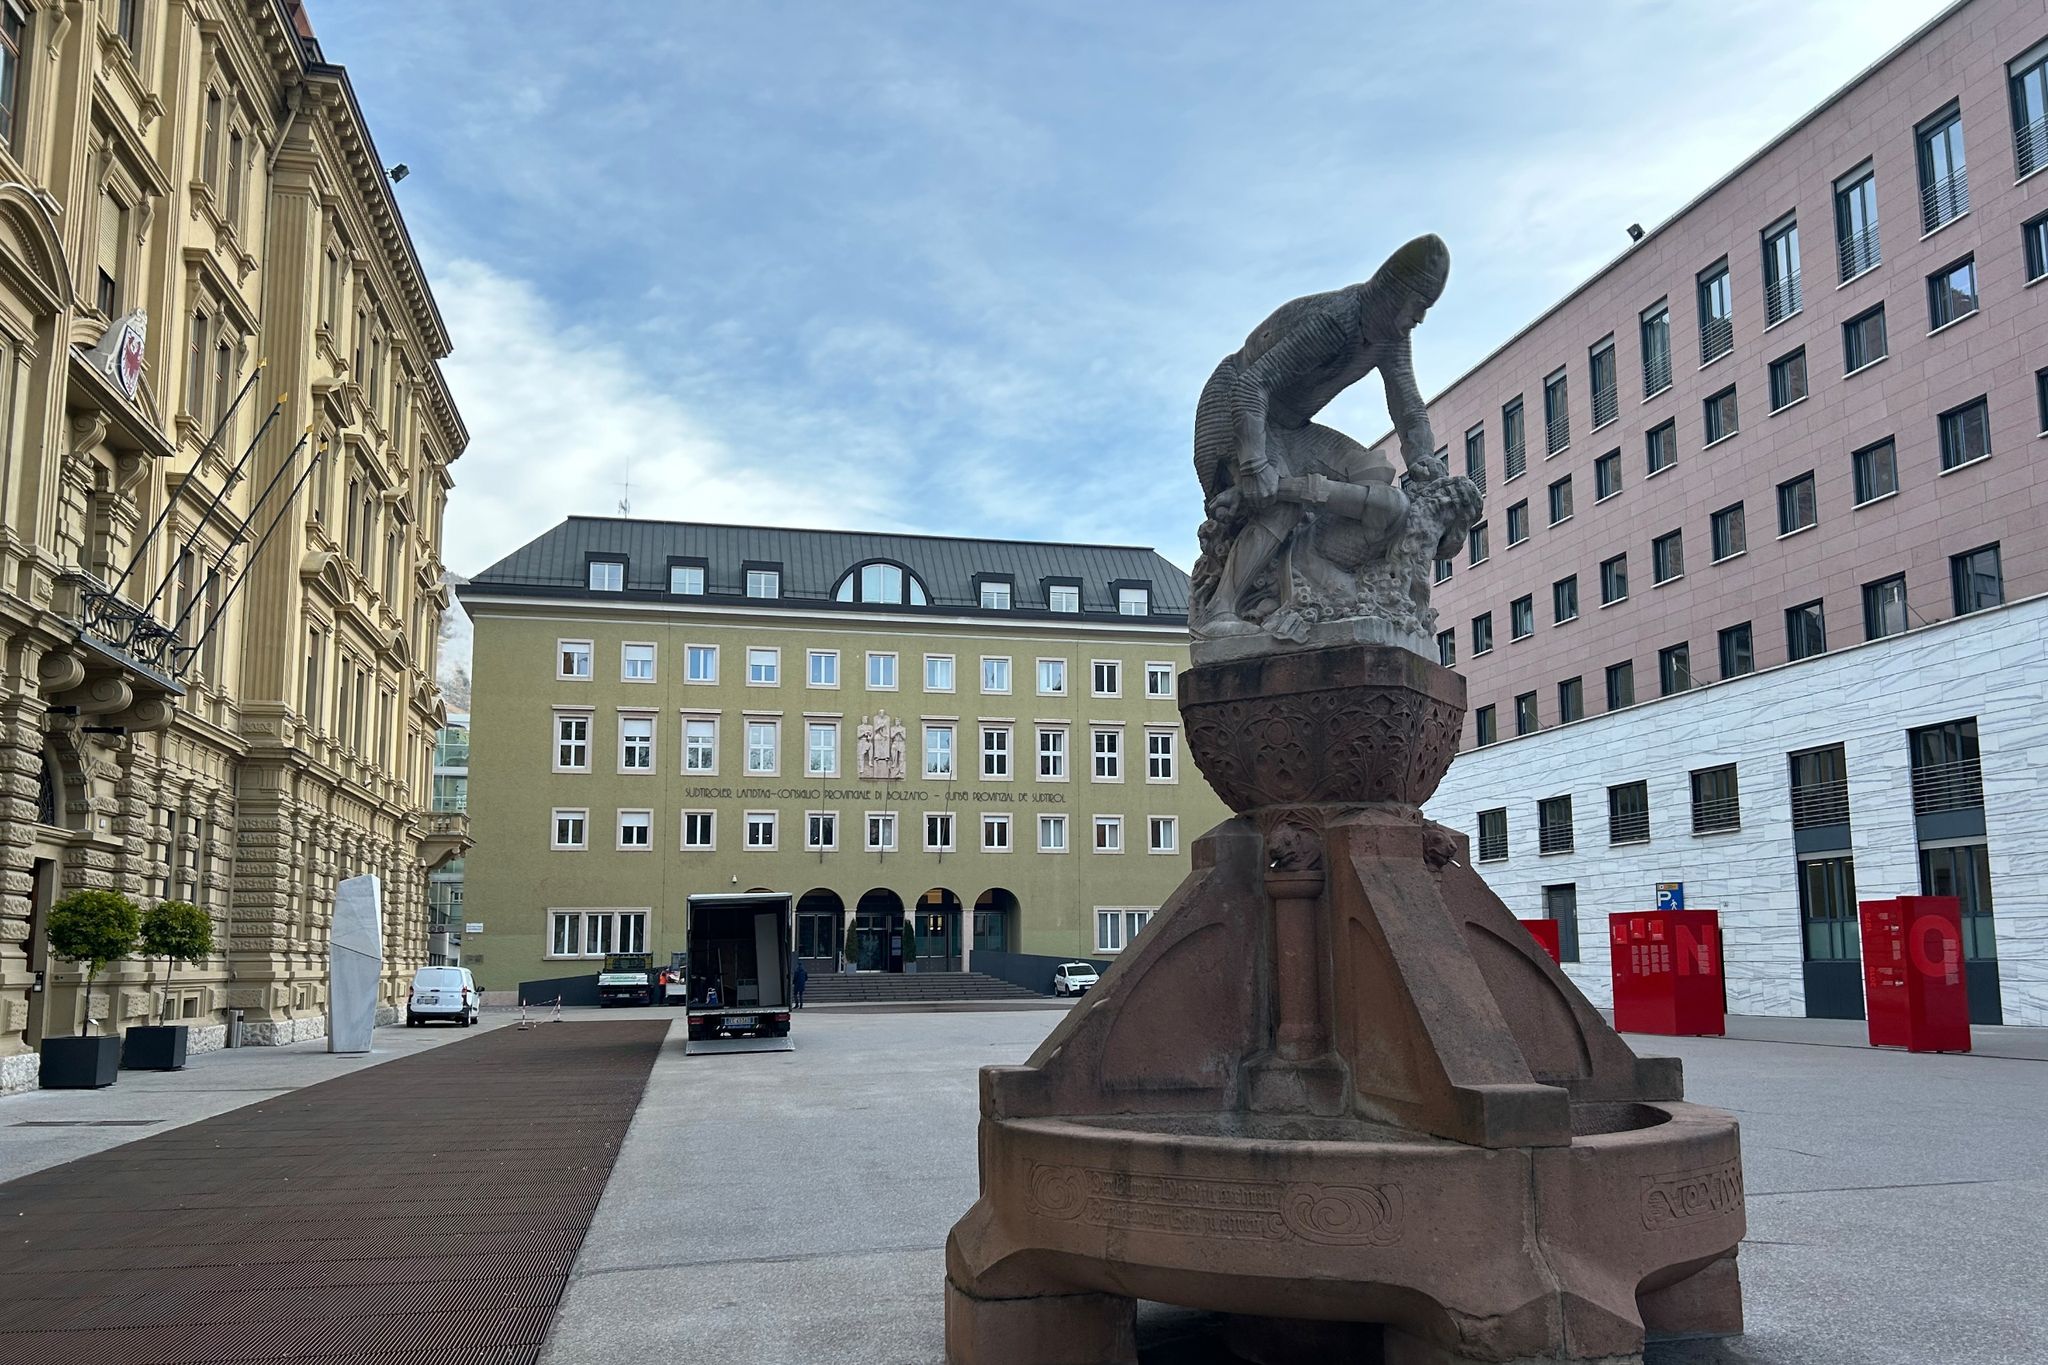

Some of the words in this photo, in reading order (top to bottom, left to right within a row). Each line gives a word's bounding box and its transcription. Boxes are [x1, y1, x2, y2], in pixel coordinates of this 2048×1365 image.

[875, 790, 882, 800] DI
[887, 790, 929, 801] BOLZANO
[973, 791, 1015, 802] PROVINZIAL
[1018, 792, 1028, 802] DE
[1657, 891, 1672, 907] P
[1675, 925, 1716, 976] N
